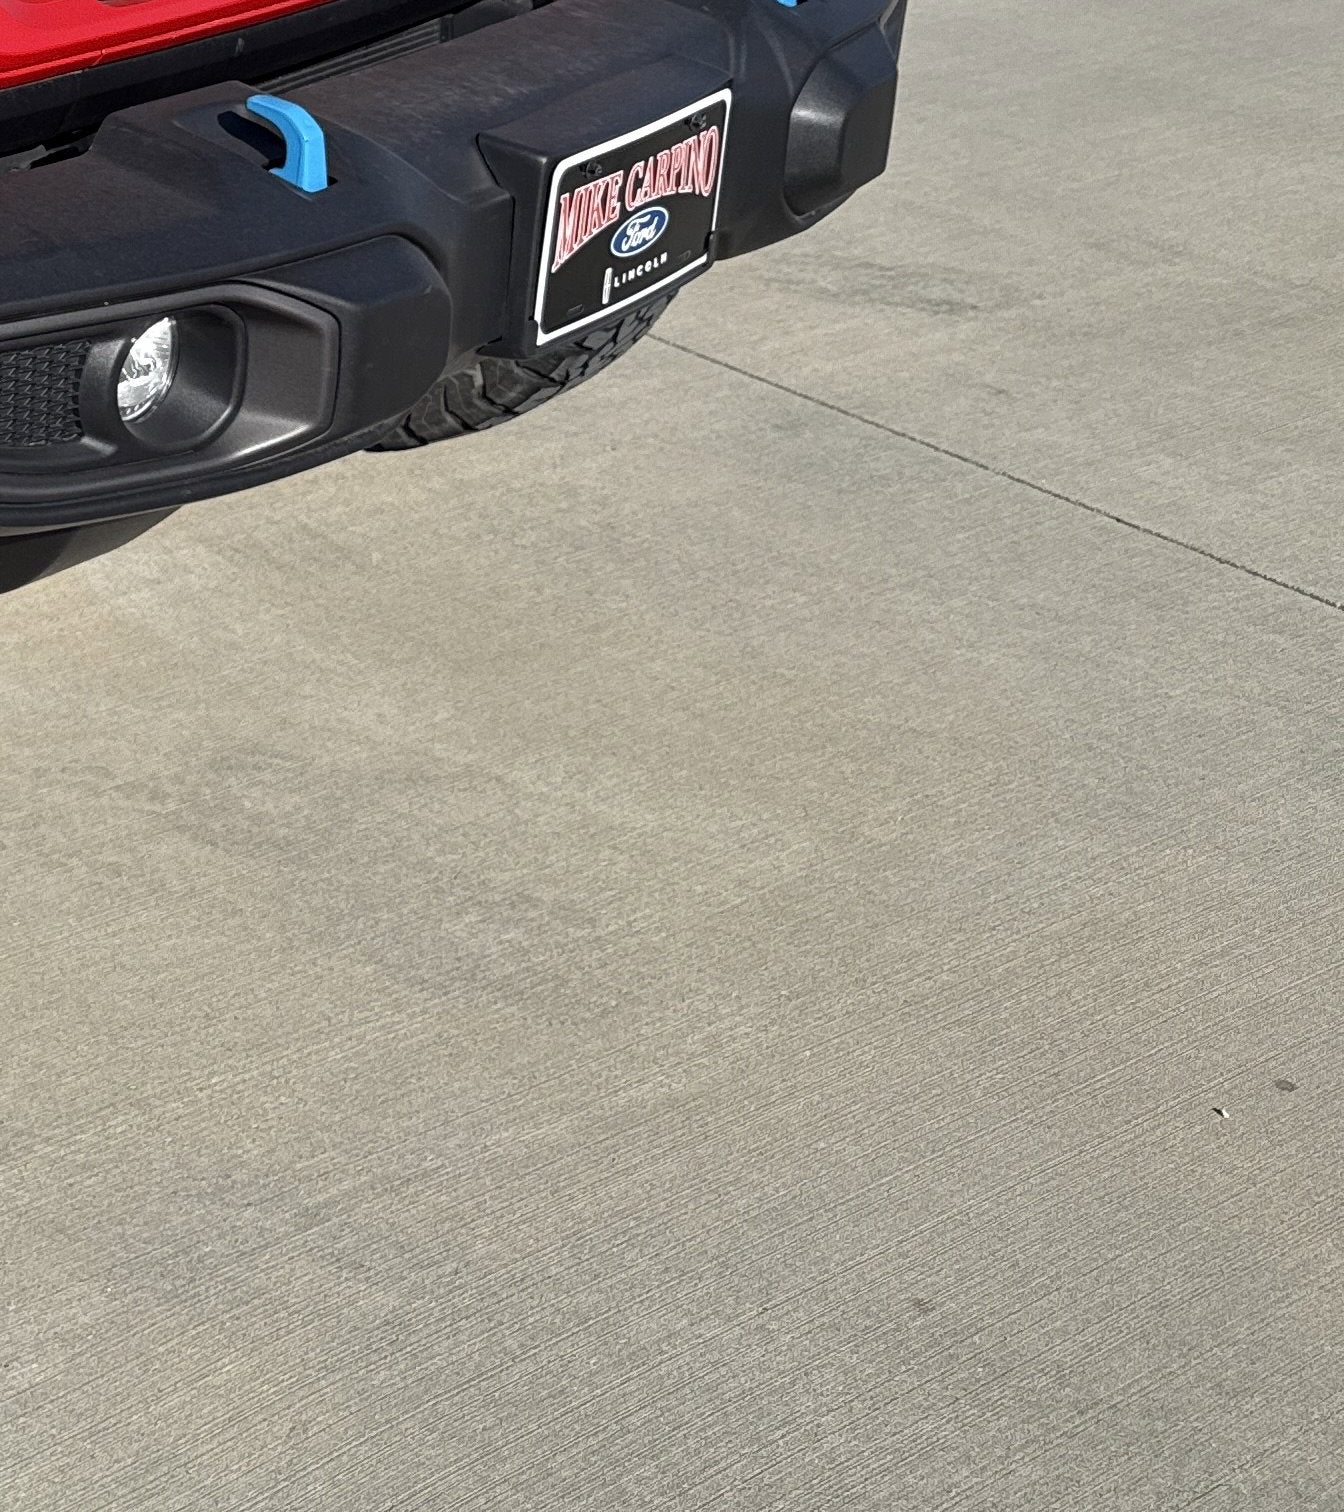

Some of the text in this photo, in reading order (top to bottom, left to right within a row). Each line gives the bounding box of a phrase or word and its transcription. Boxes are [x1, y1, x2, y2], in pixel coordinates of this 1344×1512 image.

[551, 125, 719, 274] MIKE CARPINO
[621, 214, 659, 252] Ford
[614, 252, 667, 288] LINCOLN
